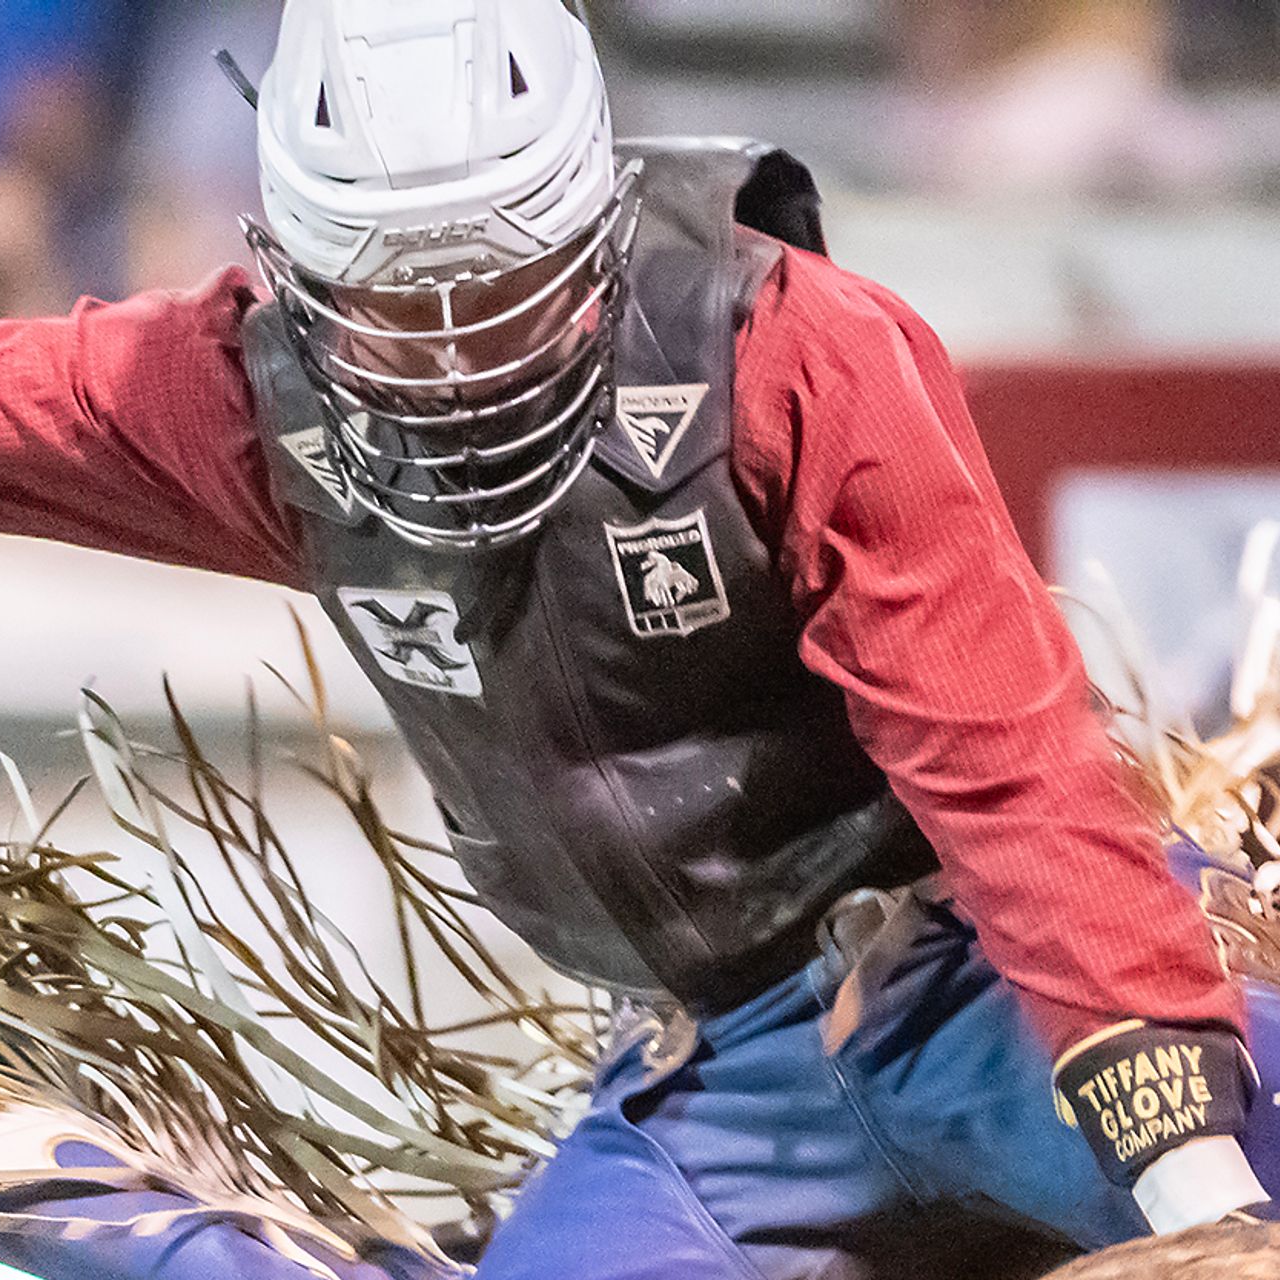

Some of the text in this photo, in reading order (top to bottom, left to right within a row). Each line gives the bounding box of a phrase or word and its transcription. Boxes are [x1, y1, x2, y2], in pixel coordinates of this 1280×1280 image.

[1077, 1043, 1202, 1112] TIFFANY
[1099, 1075, 1213, 1142] GLOVE
[1115, 1103, 1207, 1163] COMPANY
